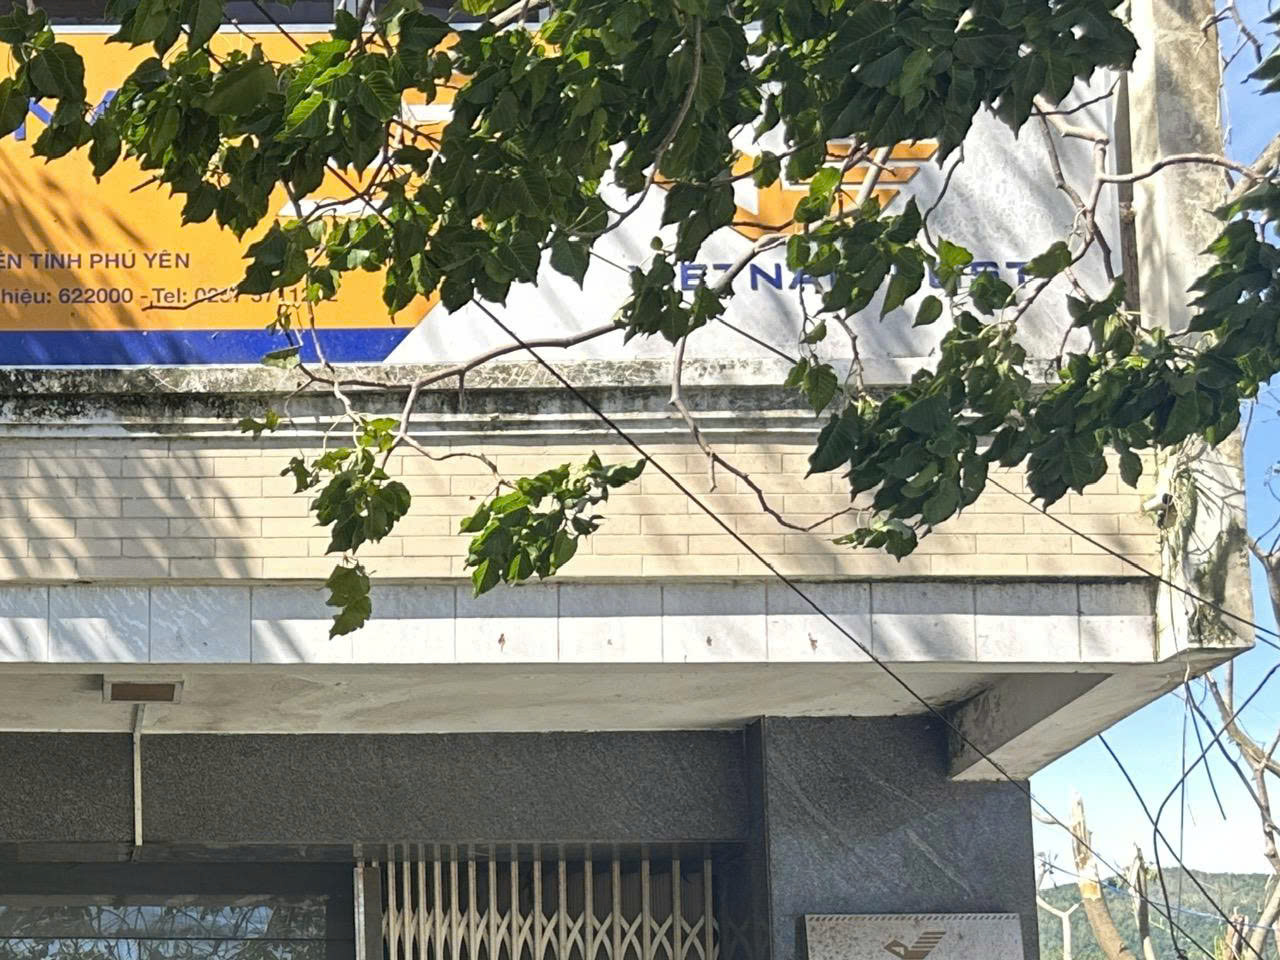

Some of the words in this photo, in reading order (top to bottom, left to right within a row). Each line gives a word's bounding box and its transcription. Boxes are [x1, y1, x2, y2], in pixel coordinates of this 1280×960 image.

[90, 249, 136, 269] PHÚ
[144, 249, 190, 269] YÊN
[1, 288, 52, 306] hiệu:
[58, 288, 133, 304] 622000
[152, 288, 187, 303] Tel:
